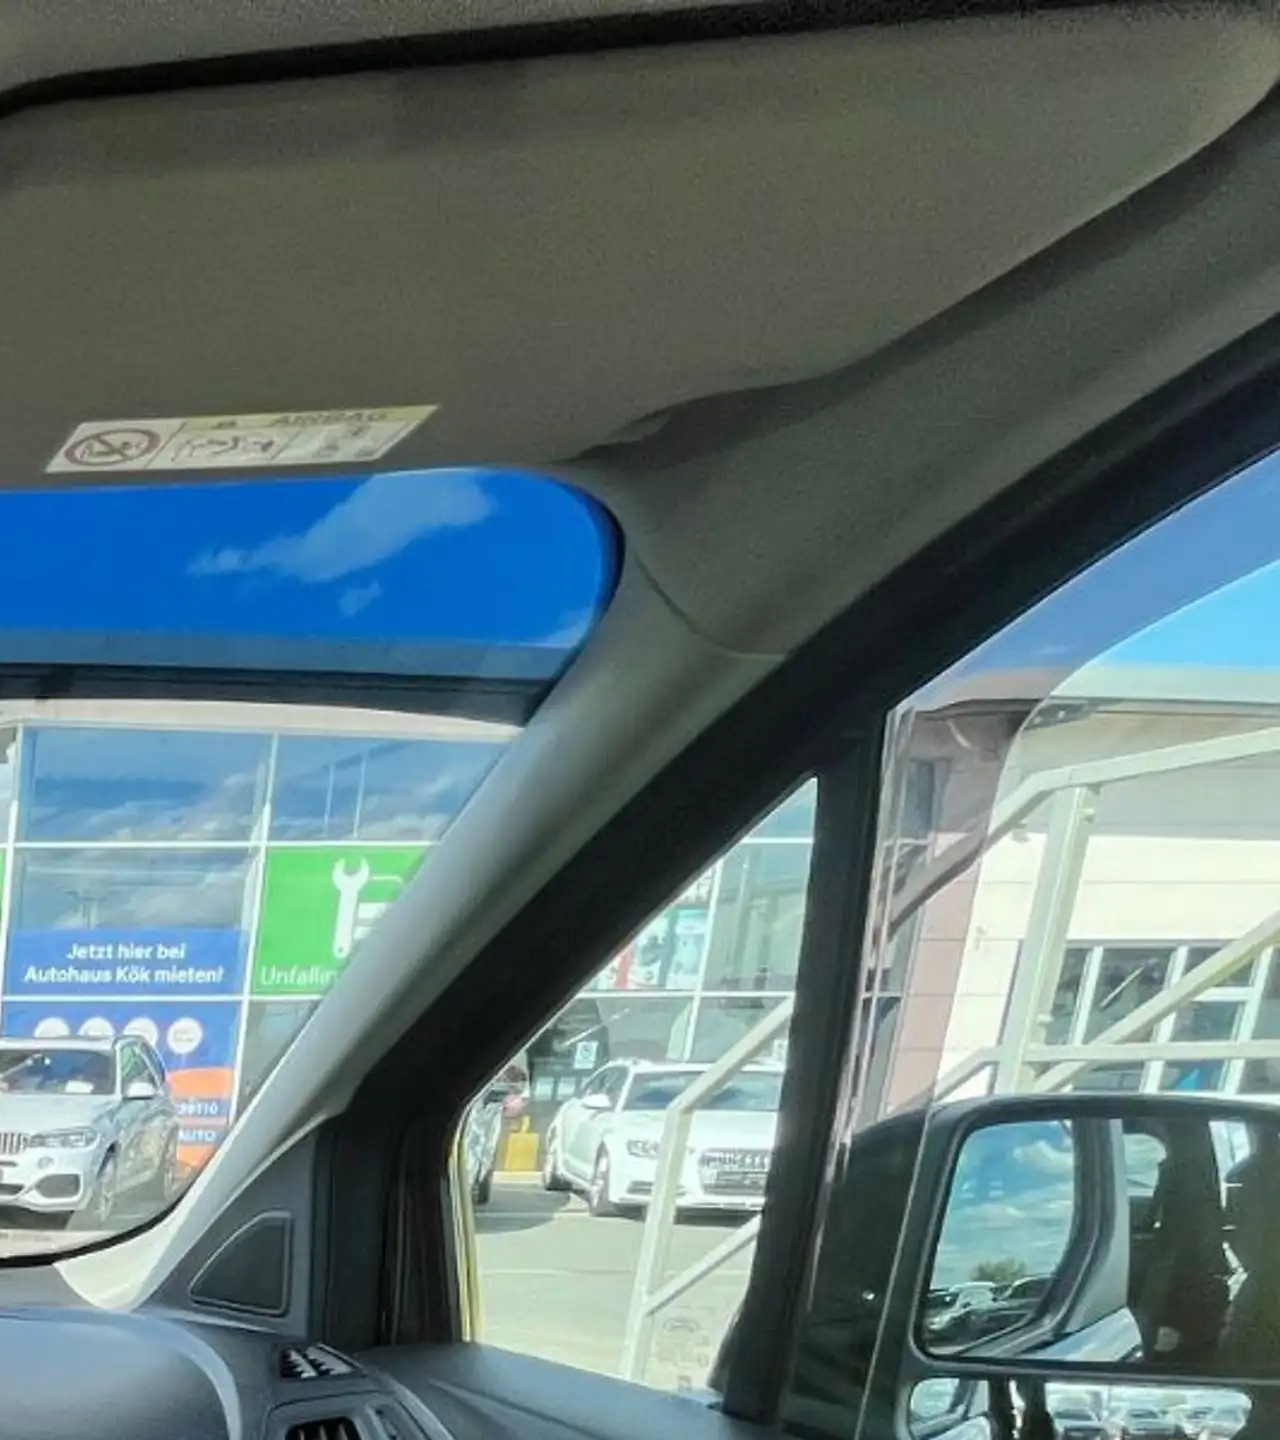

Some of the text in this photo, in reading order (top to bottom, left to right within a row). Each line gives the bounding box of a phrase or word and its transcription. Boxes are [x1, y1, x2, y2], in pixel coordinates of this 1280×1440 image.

[65, 943, 186, 959] Jetzt hier bei
[24, 965, 223, 983] Autohaus Kök mieten!
